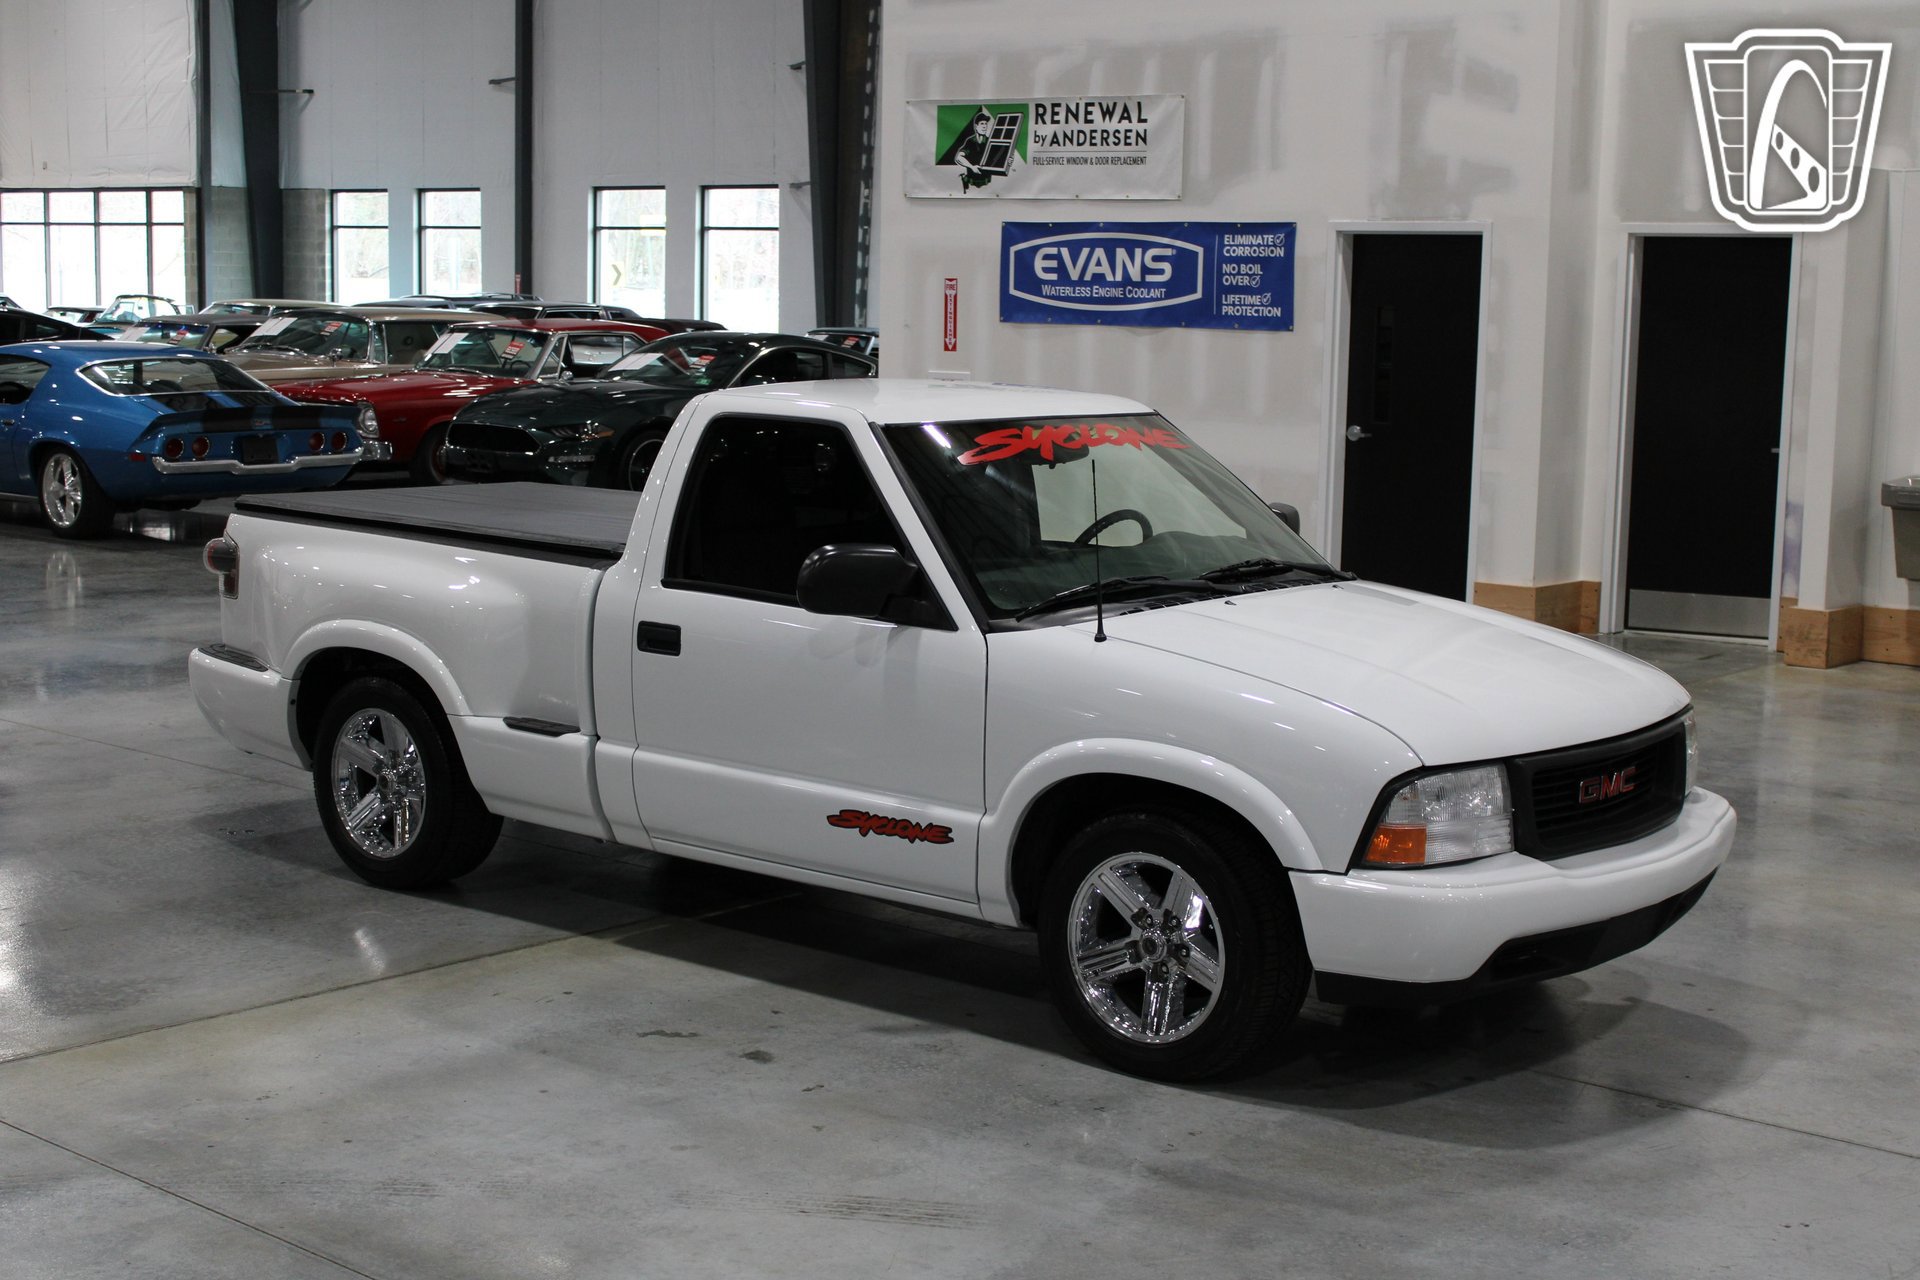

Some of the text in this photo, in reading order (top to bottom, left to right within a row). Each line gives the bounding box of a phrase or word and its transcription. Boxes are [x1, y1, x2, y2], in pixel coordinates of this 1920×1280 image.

[1034, 101, 1148, 125] RENEWAL
[1033, 128, 1148, 147] by ANDERSEN
[1032, 156, 1147, 166] FULL-SERVICE WINDOW & DOOR REPLACEMENT
[1224, 234, 1274, 245] ELIMINATE
[1223, 246, 1284, 257] CORROSION
[1034, 247, 1173, 282] EVANS
[1222, 263, 1263, 275] NO BOIL
[1222, 275, 1250, 286] OVER
[1222, 294, 1262, 305] LIFETIME
[1221, 305, 1281, 317] PROTECTION
[1579, 766, 1638, 804] GMC
